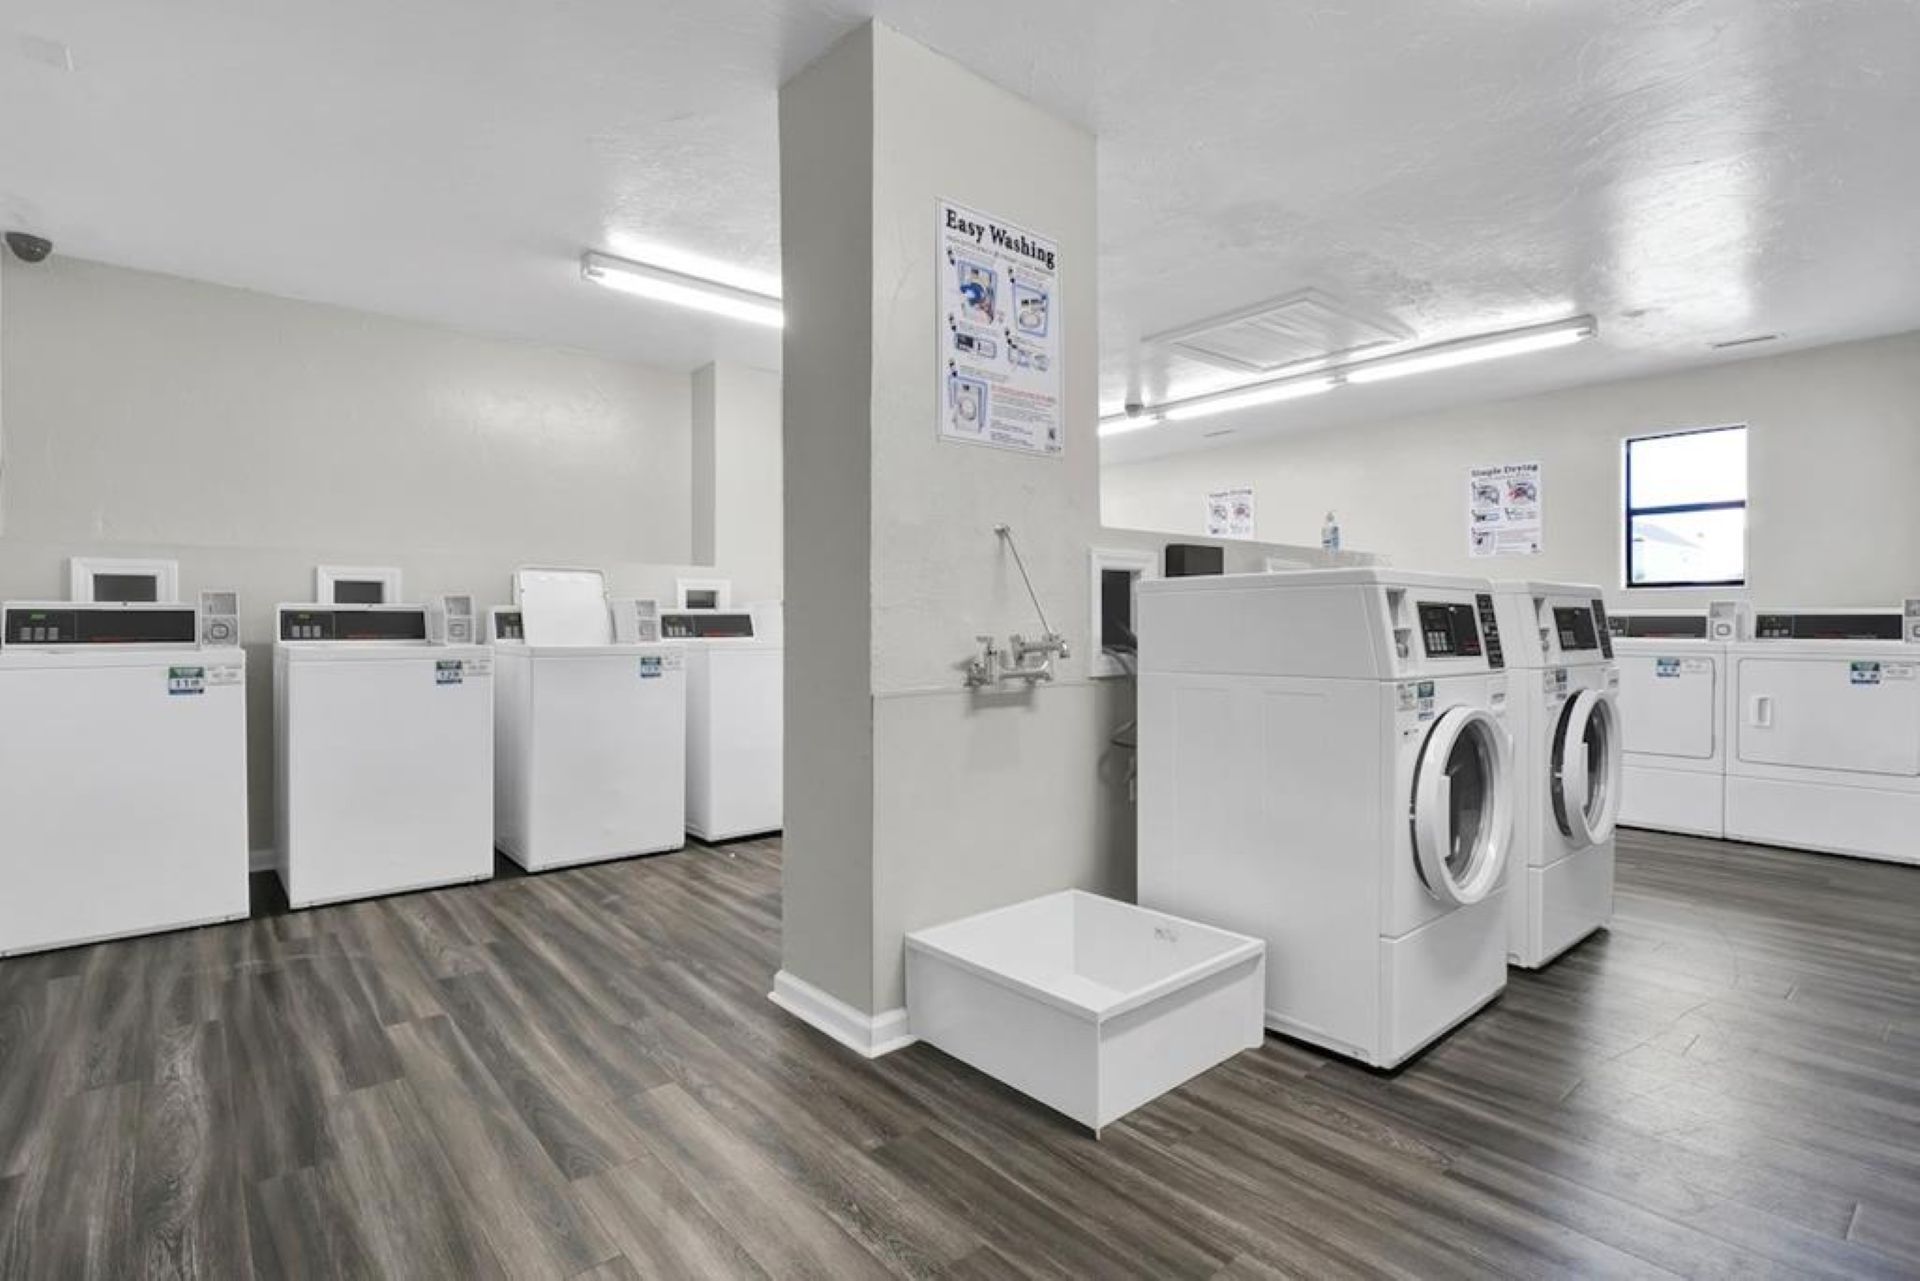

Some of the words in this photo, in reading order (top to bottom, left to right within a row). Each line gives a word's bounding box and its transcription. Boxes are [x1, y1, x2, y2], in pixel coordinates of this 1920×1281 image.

[946, 209, 985, 243] Easy
[989, 225, 1055, 270] Washing
[1471, 467, 1502, 477] Simple
[1504, 464, 1538, 474] Drying
